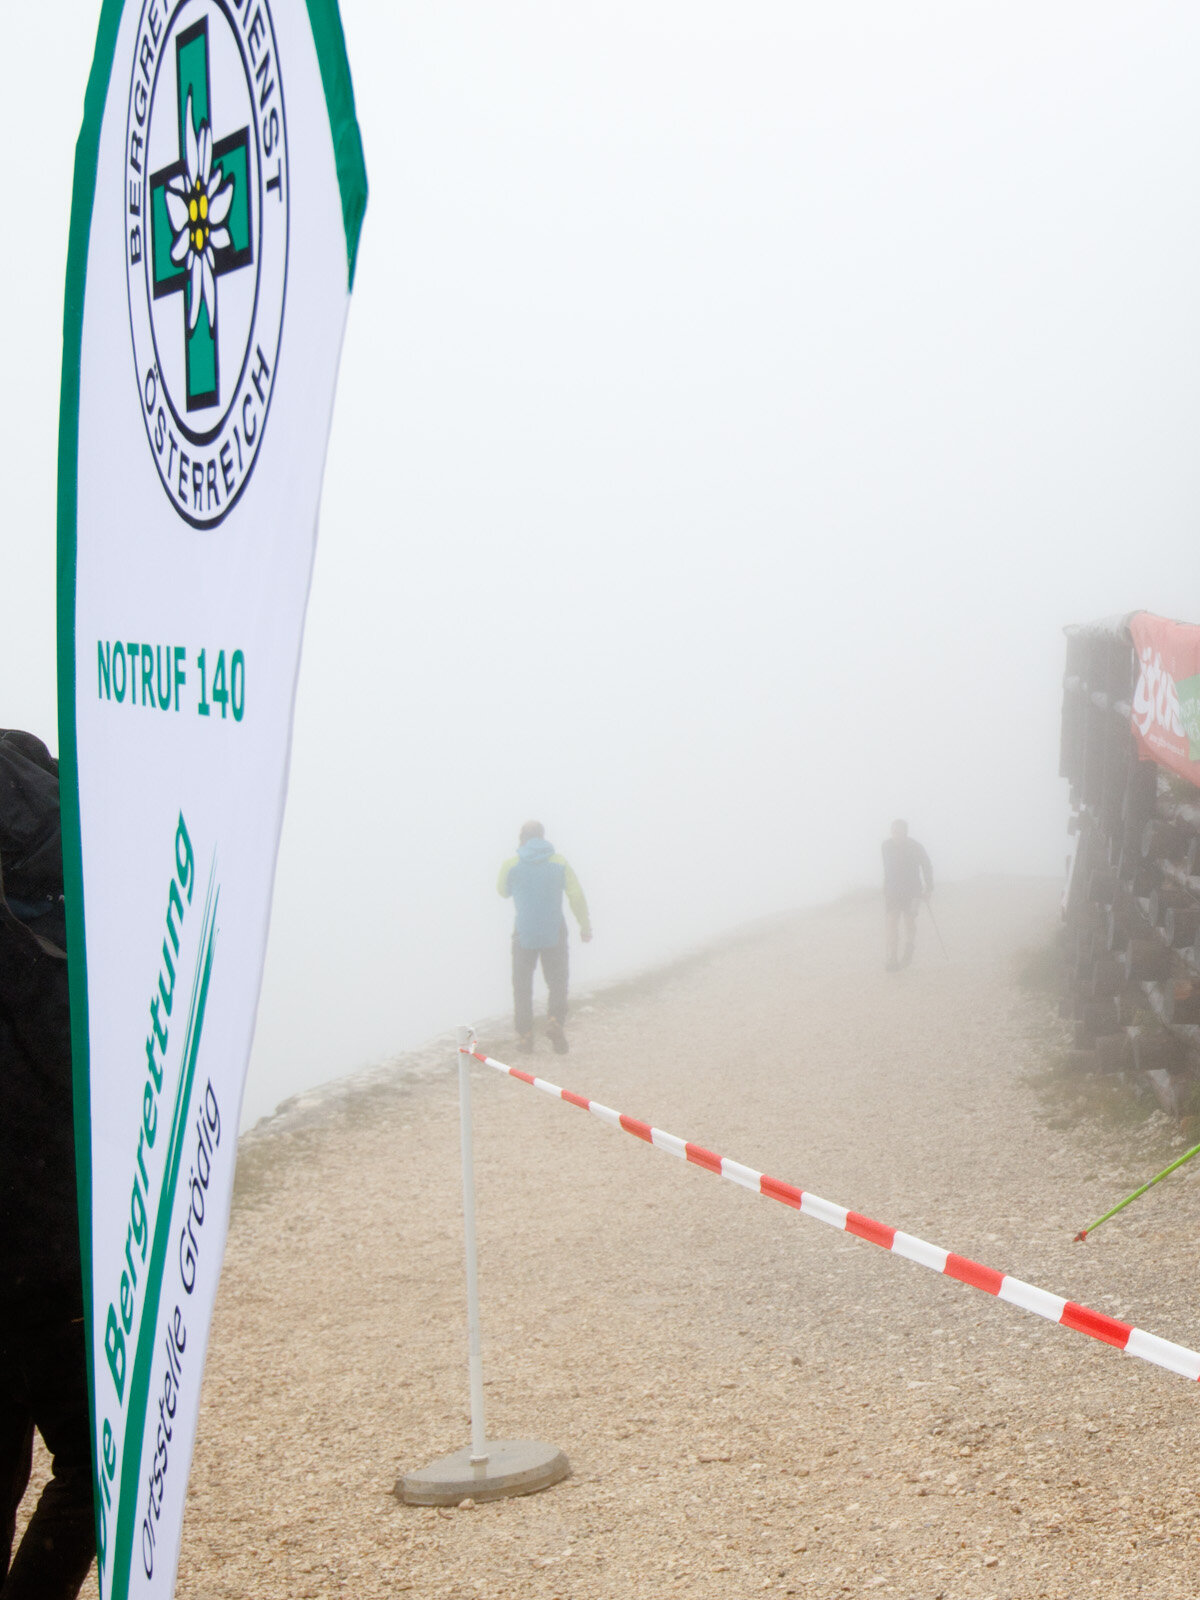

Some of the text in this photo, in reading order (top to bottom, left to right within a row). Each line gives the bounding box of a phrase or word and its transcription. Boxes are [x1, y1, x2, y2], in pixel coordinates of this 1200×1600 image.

[145, 345, 272, 511] ÖSTERREICH
[97, 640, 245, 722] NOTRUF 140
[104, 809, 194, 1406] Bergrettung
[142, 1077, 221, 1580] Ortsstelle Grödig
